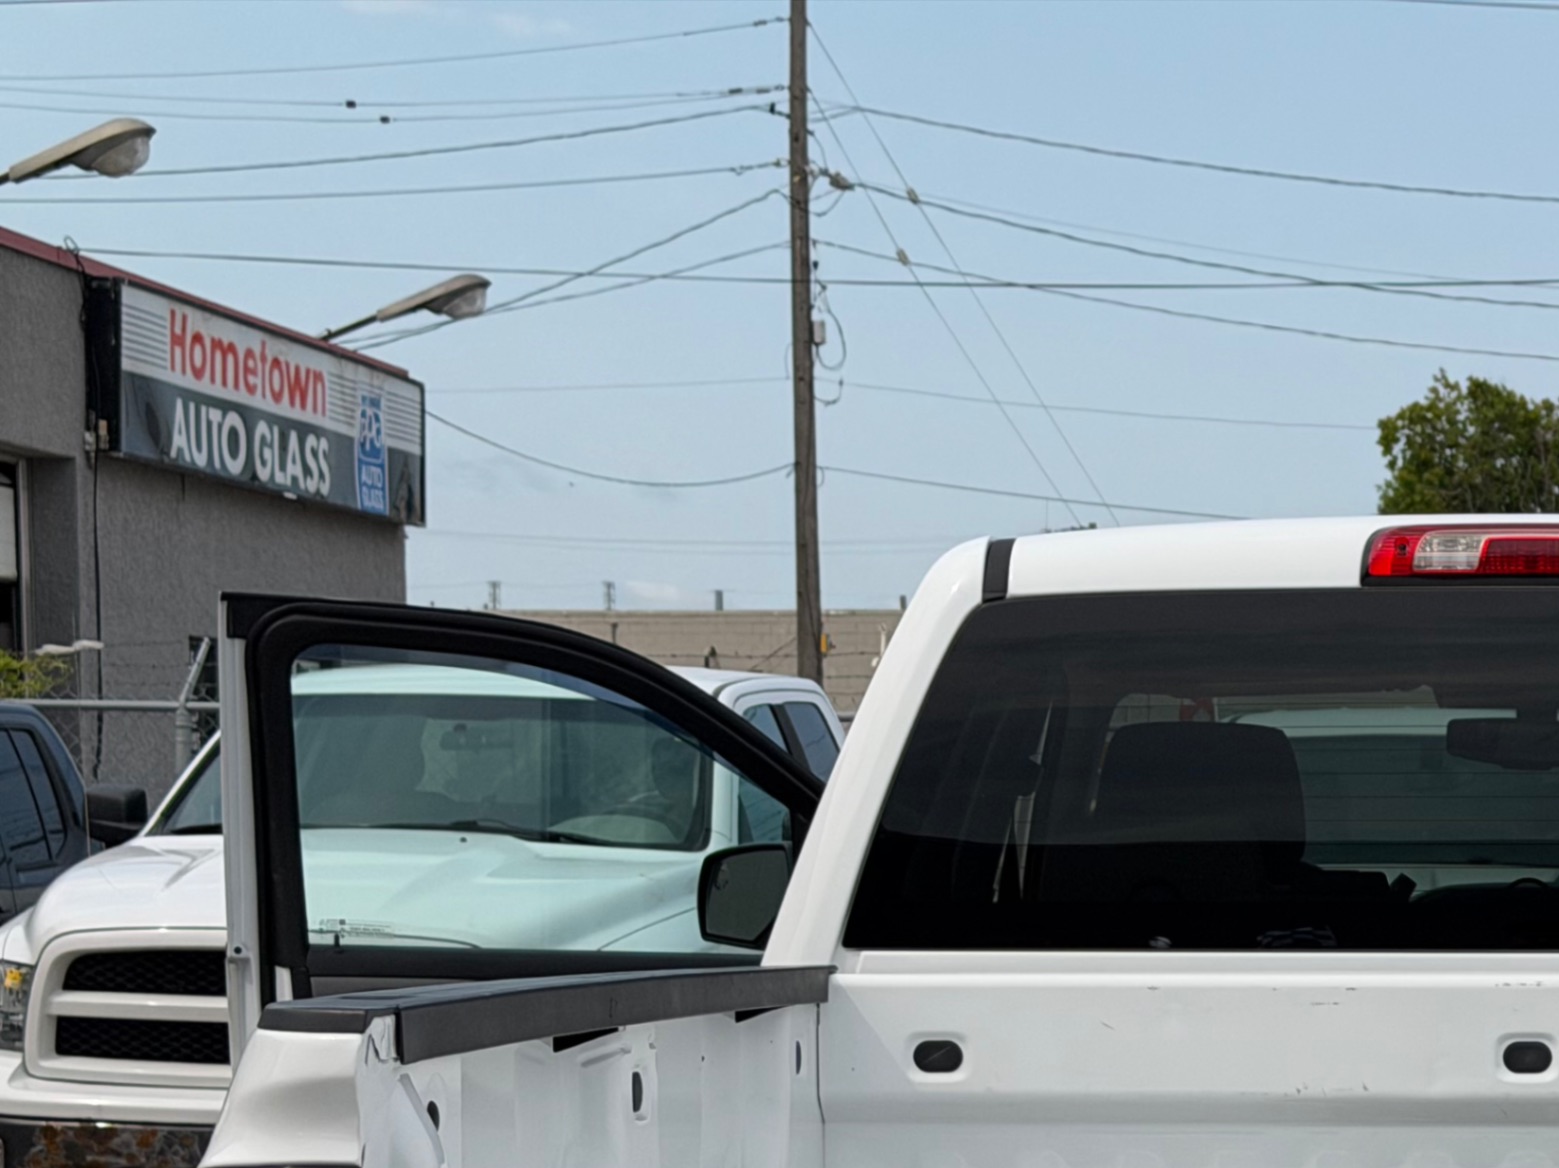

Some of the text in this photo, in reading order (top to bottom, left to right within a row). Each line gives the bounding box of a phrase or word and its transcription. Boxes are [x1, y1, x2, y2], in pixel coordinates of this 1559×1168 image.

[168, 308, 327, 418] Hometown
[170, 396, 331, 498] AUTO GLASS
[361, 465, 383, 488] AUTO
